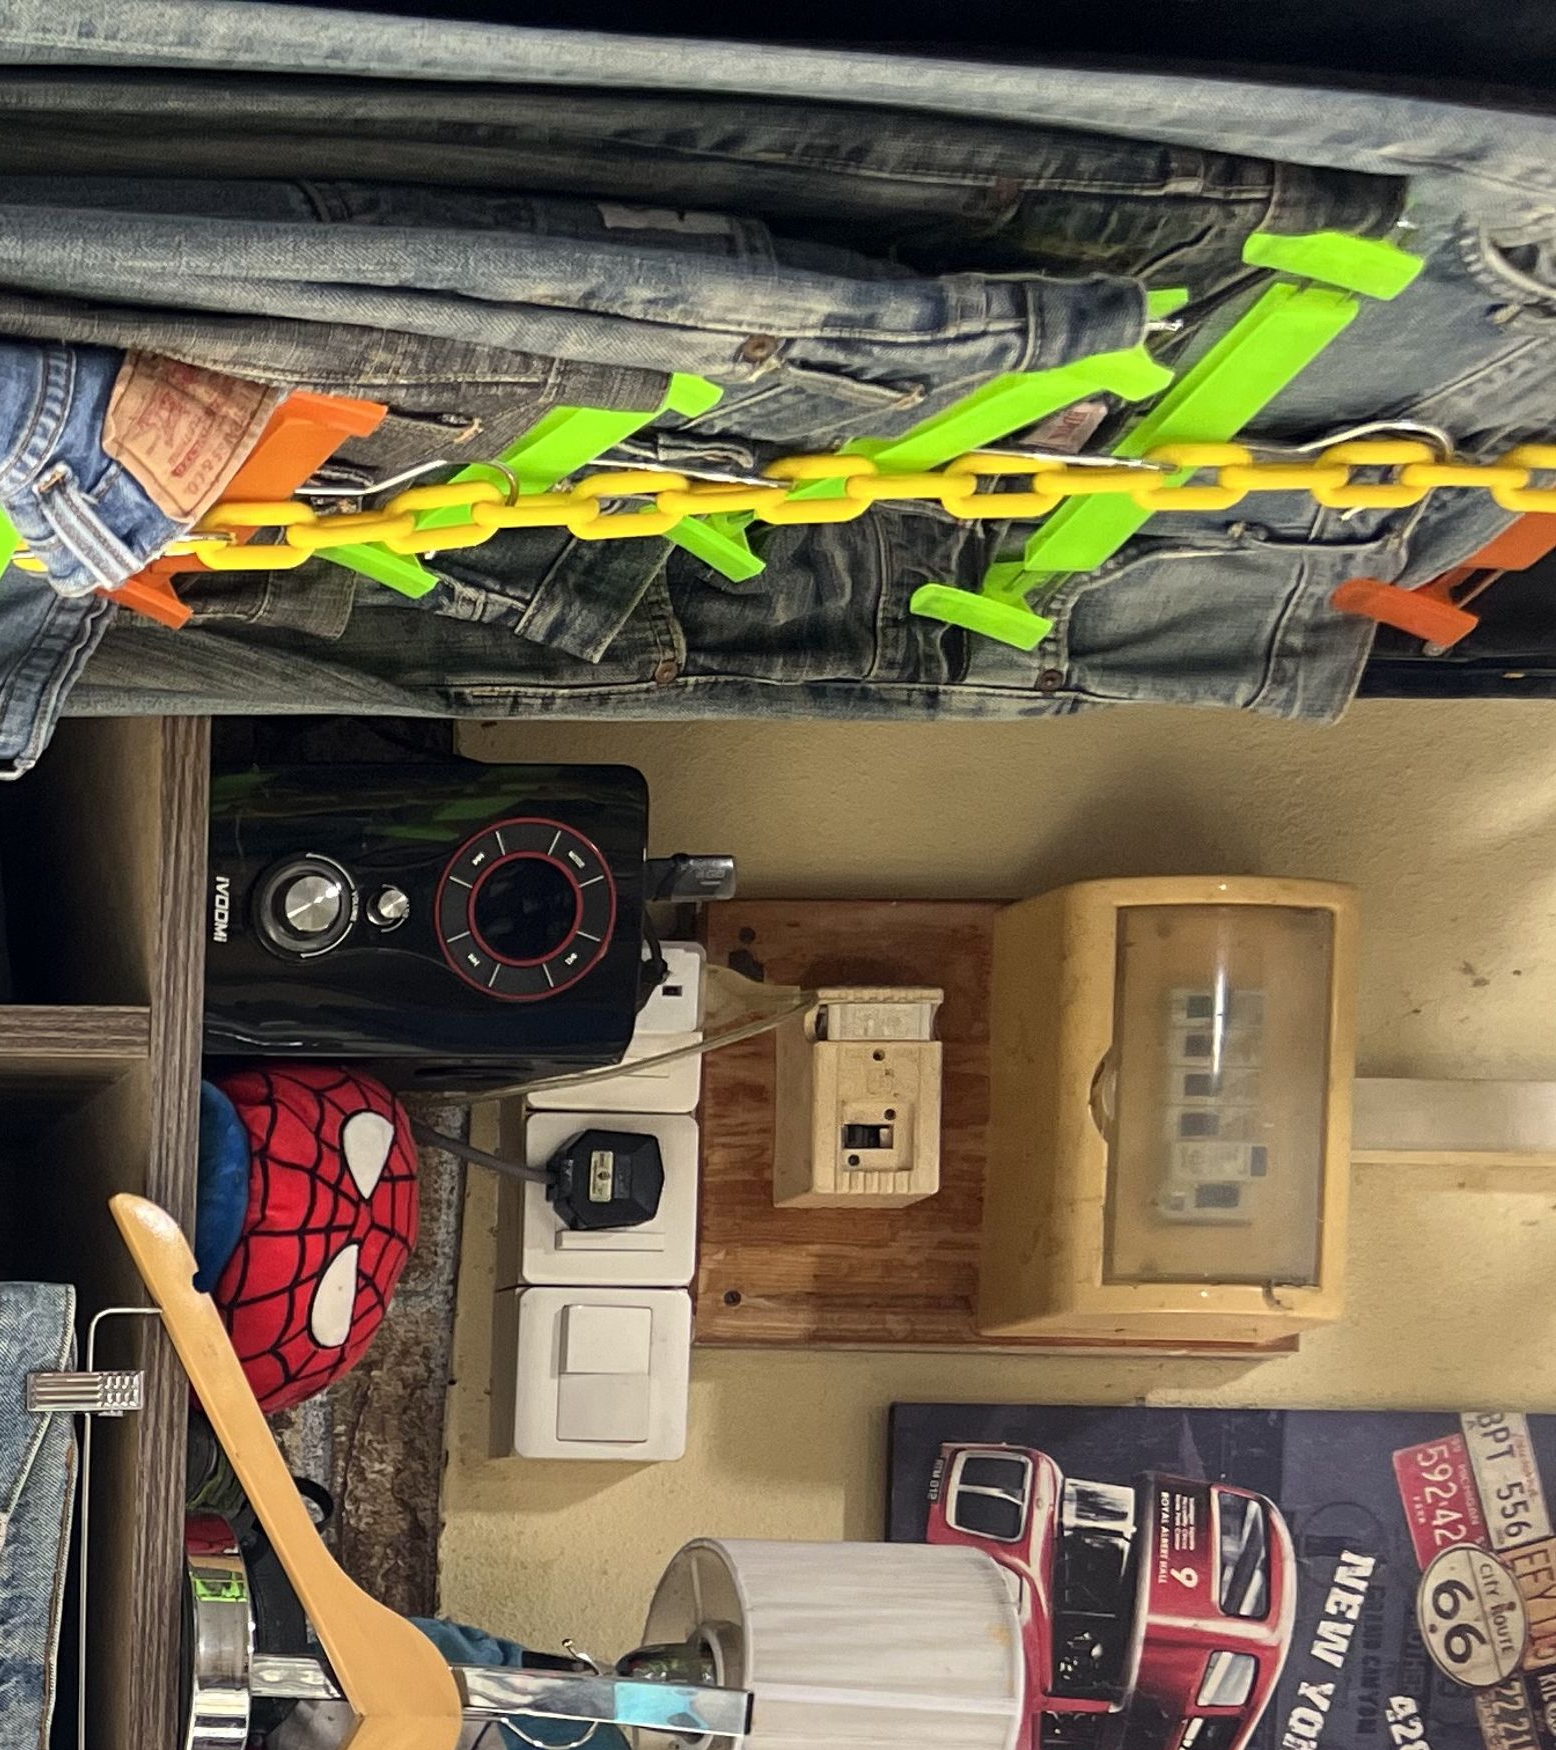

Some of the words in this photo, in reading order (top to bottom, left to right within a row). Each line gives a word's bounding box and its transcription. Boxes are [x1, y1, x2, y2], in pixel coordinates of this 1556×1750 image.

[1475, 1413, 1514, 1460] BPT
[1496, 1482, 1532, 1538] 556
[1160, 1491, 1170, 1524] ROYAL
[1159, 1526, 1170, 1560] ALBERT
[1158, 1560, 1168, 1584] HALL
[1170, 1567, 1199, 1588] 9
[1479, 1563, 1501, 1597] CITY
[1310, 1551, 1376, 1669] NEW
[1432, 1580, 1488, 1664] 66
